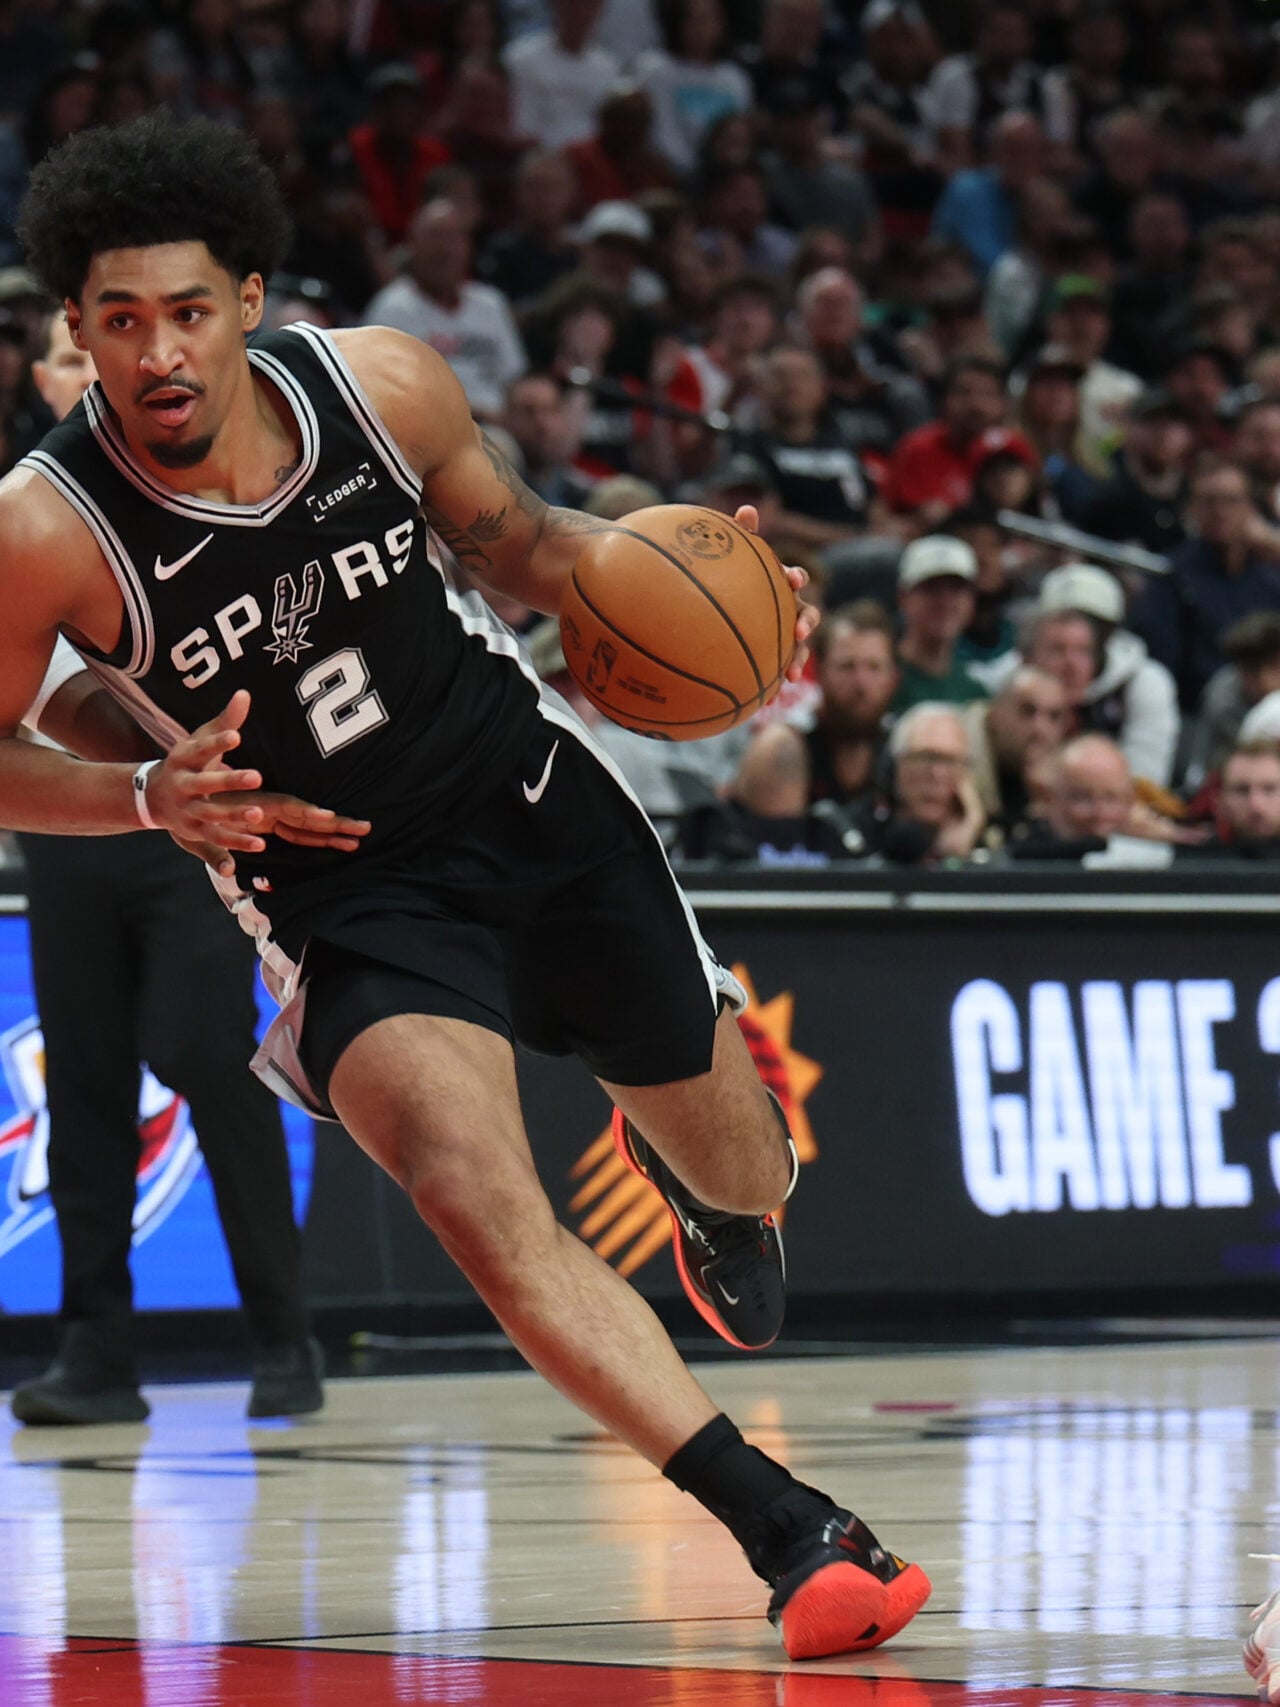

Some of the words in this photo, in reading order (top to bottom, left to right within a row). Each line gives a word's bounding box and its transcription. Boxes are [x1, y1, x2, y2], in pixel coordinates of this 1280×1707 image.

[317, 474, 367, 512] LEDGER
[170, 518, 414, 690] SPURS
[295, 647, 390, 759] 2
[949, 978, 1253, 1217] GAME
